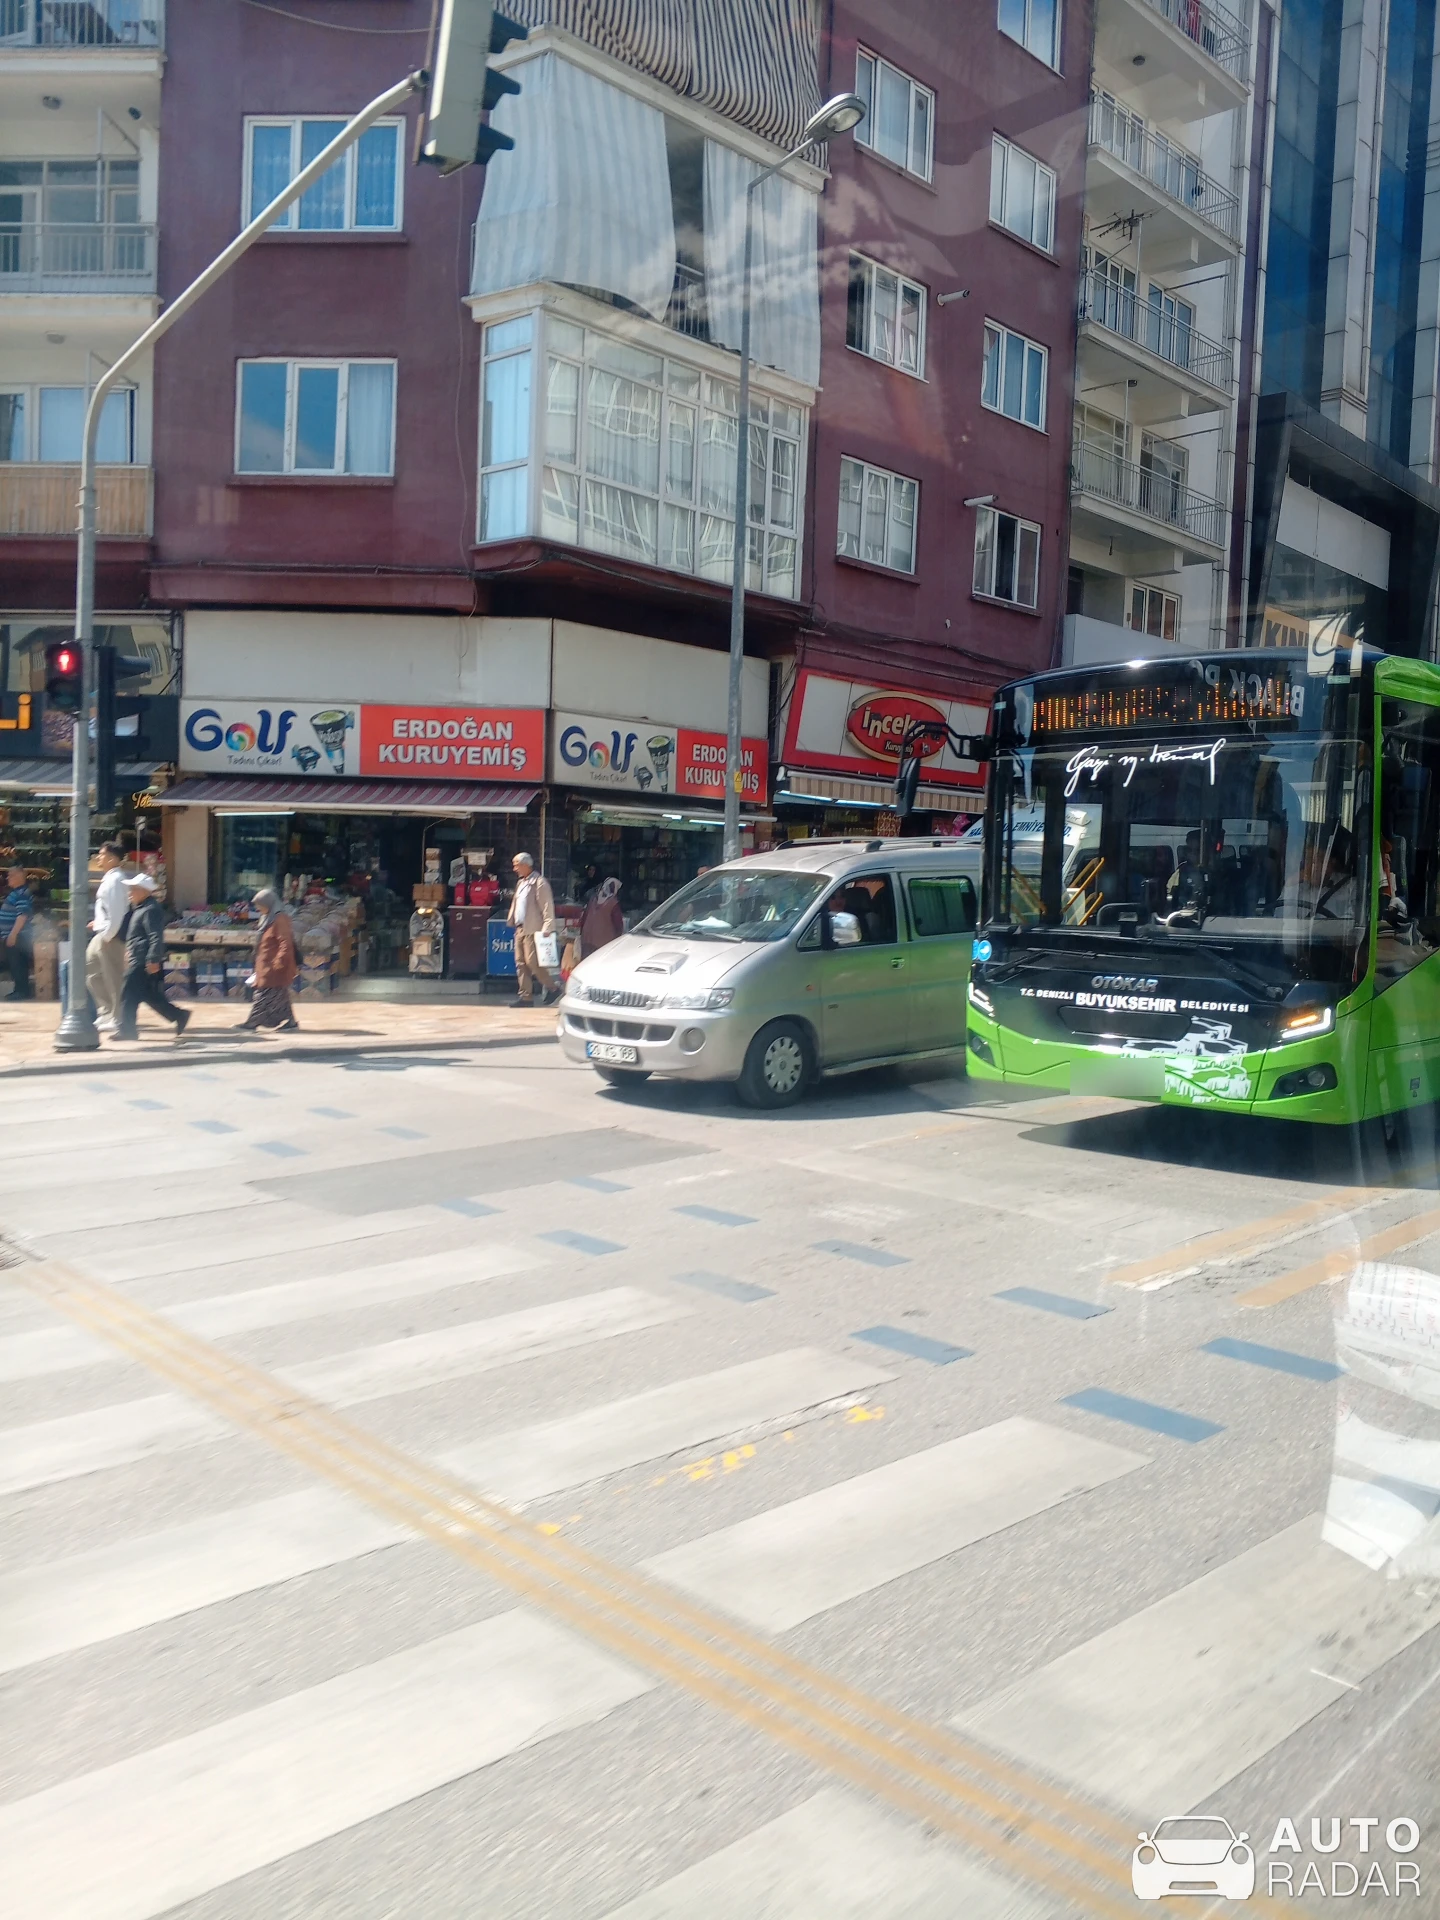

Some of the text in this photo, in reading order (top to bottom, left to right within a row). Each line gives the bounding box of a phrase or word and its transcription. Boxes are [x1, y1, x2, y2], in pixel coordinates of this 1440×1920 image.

[185, 708, 297, 755] Golf
[392, 716, 513, 741] ERDOĞAN
[378, 742, 527, 772] KURUYEMİŞ
[559, 725, 638, 773] Golf
[692, 743, 754, 767] ERDOAN
[685, 766, 760, 793] KURUYMİŞ
[1013, 819, 1045, 833] EMNİYE
[1091, 975, 1159, 993] OTOKAR
